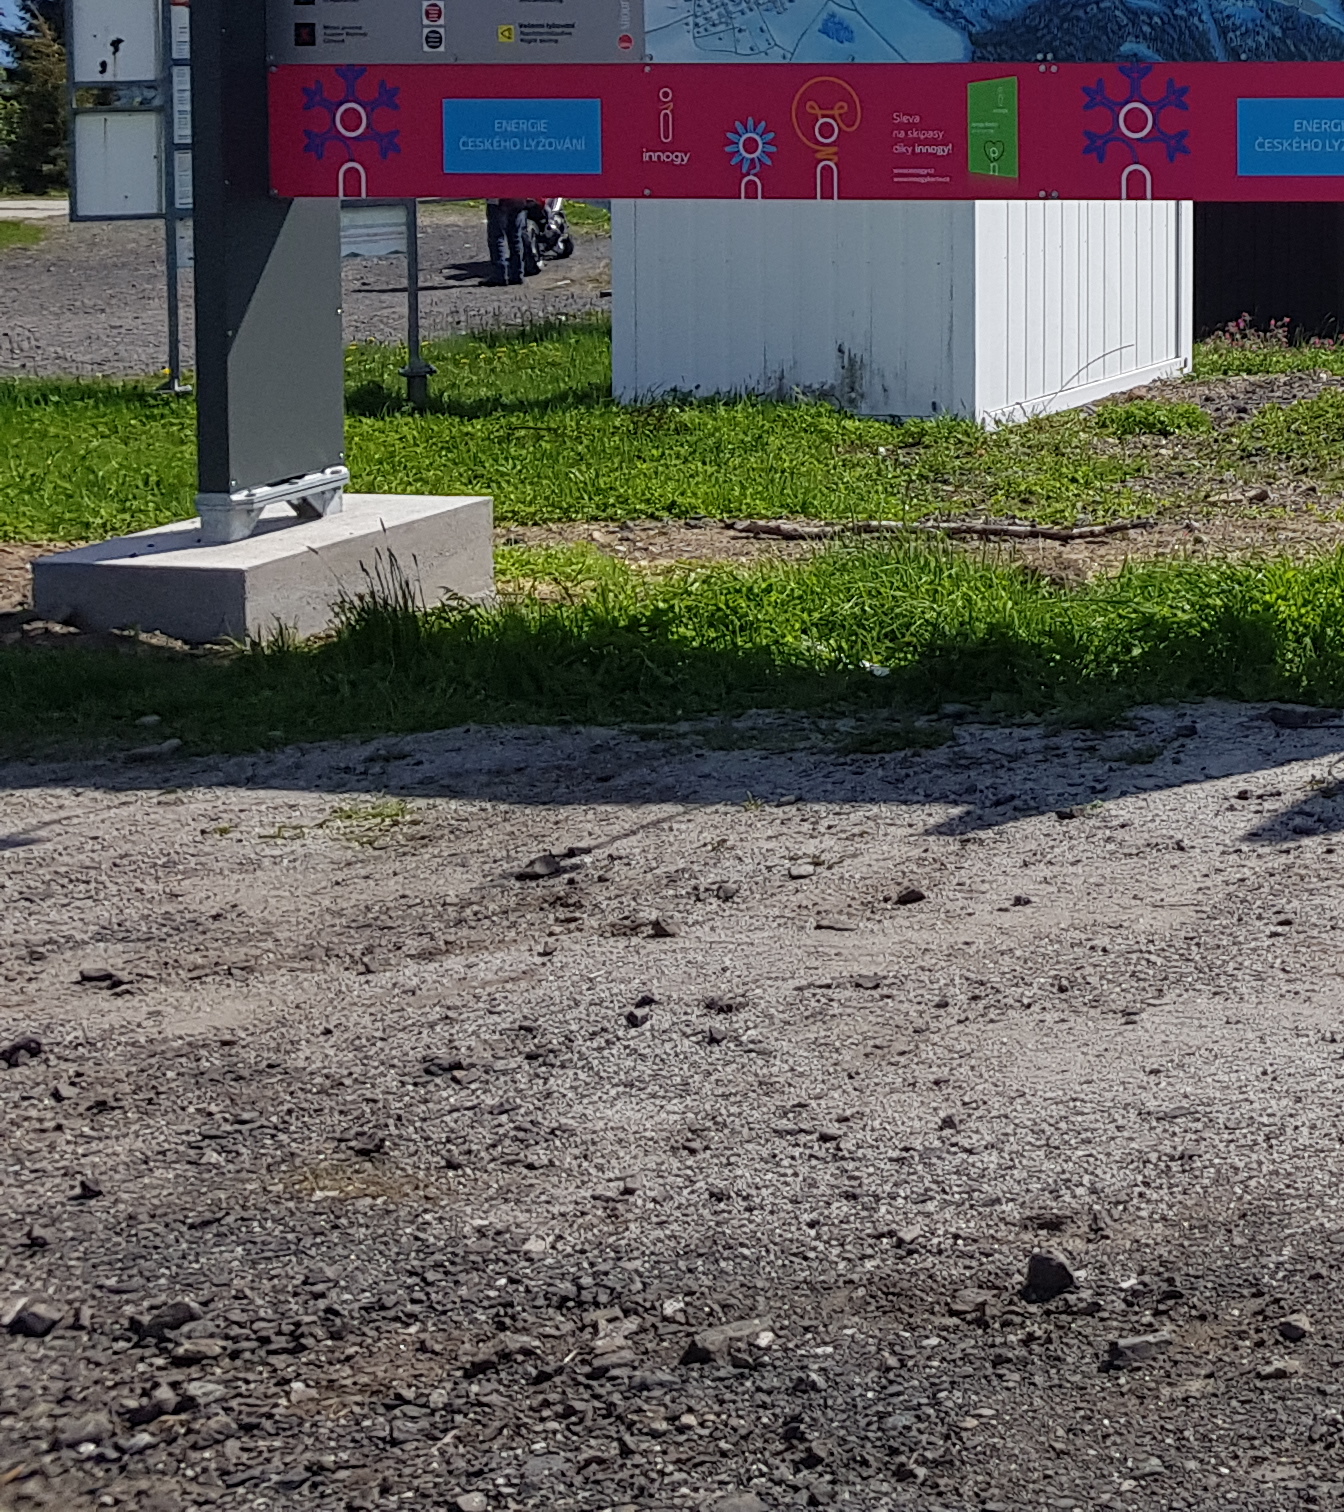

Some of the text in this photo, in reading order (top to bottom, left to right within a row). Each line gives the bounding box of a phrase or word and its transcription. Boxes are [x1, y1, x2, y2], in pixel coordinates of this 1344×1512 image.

[892, 113, 919, 123] Sleva
[495, 120, 548, 133] ENERGIE
[908, 129, 944, 140] skipasy
[459, 136, 520, 150] ČESKÉHO
[915, 144, 952, 155] innogy!
[1255, 137, 1322, 151] ČESKÉHO
[642, 150, 690, 164] innogy
